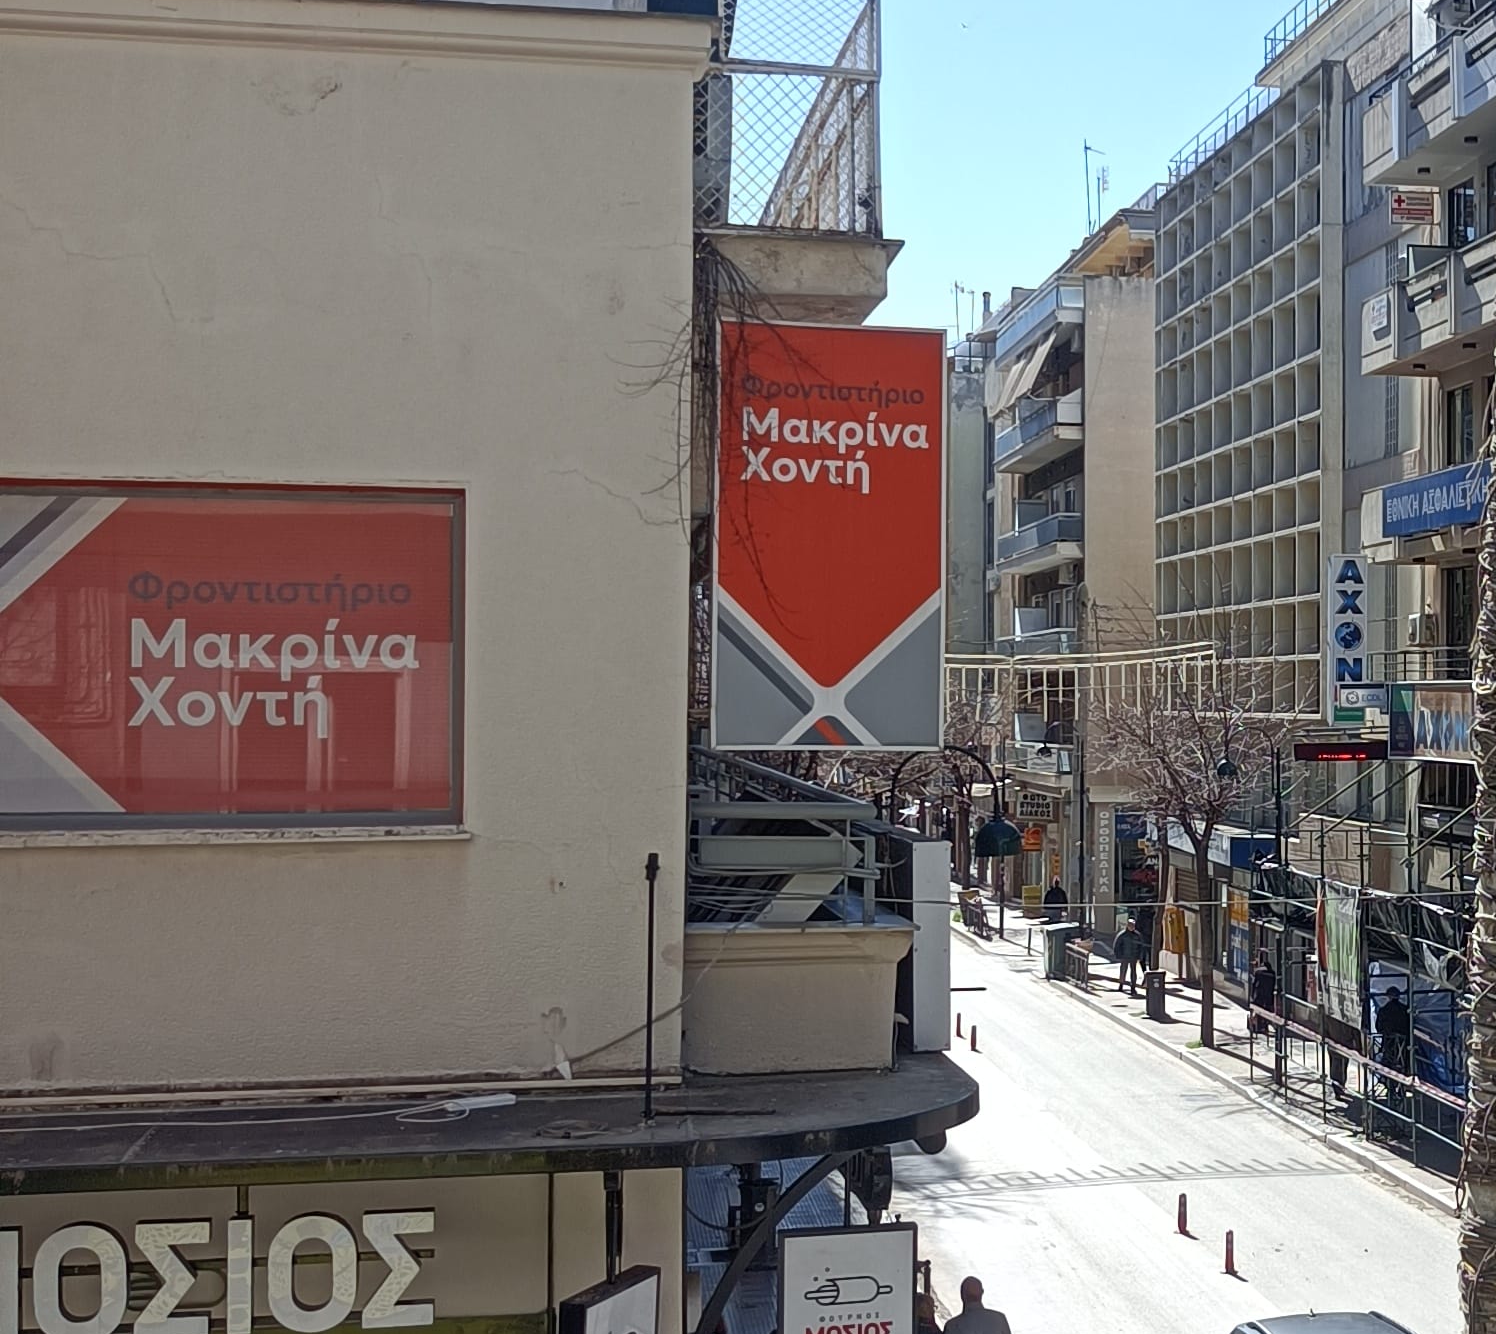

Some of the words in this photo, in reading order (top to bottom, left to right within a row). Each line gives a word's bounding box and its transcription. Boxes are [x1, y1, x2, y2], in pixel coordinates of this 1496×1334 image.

[740, 371, 926, 409] Φροντιστήριο
[742, 406, 929, 454] Μακρίνα
[740, 445, 870, 495] Χοντή
[1386, 493, 1420, 524] ΕΘΝΙΚΗ
[128, 571, 412, 611] Φροντιστήριο
[130, 618, 420, 682] Μακρίνα
[127, 674, 329, 739] Χοντή
